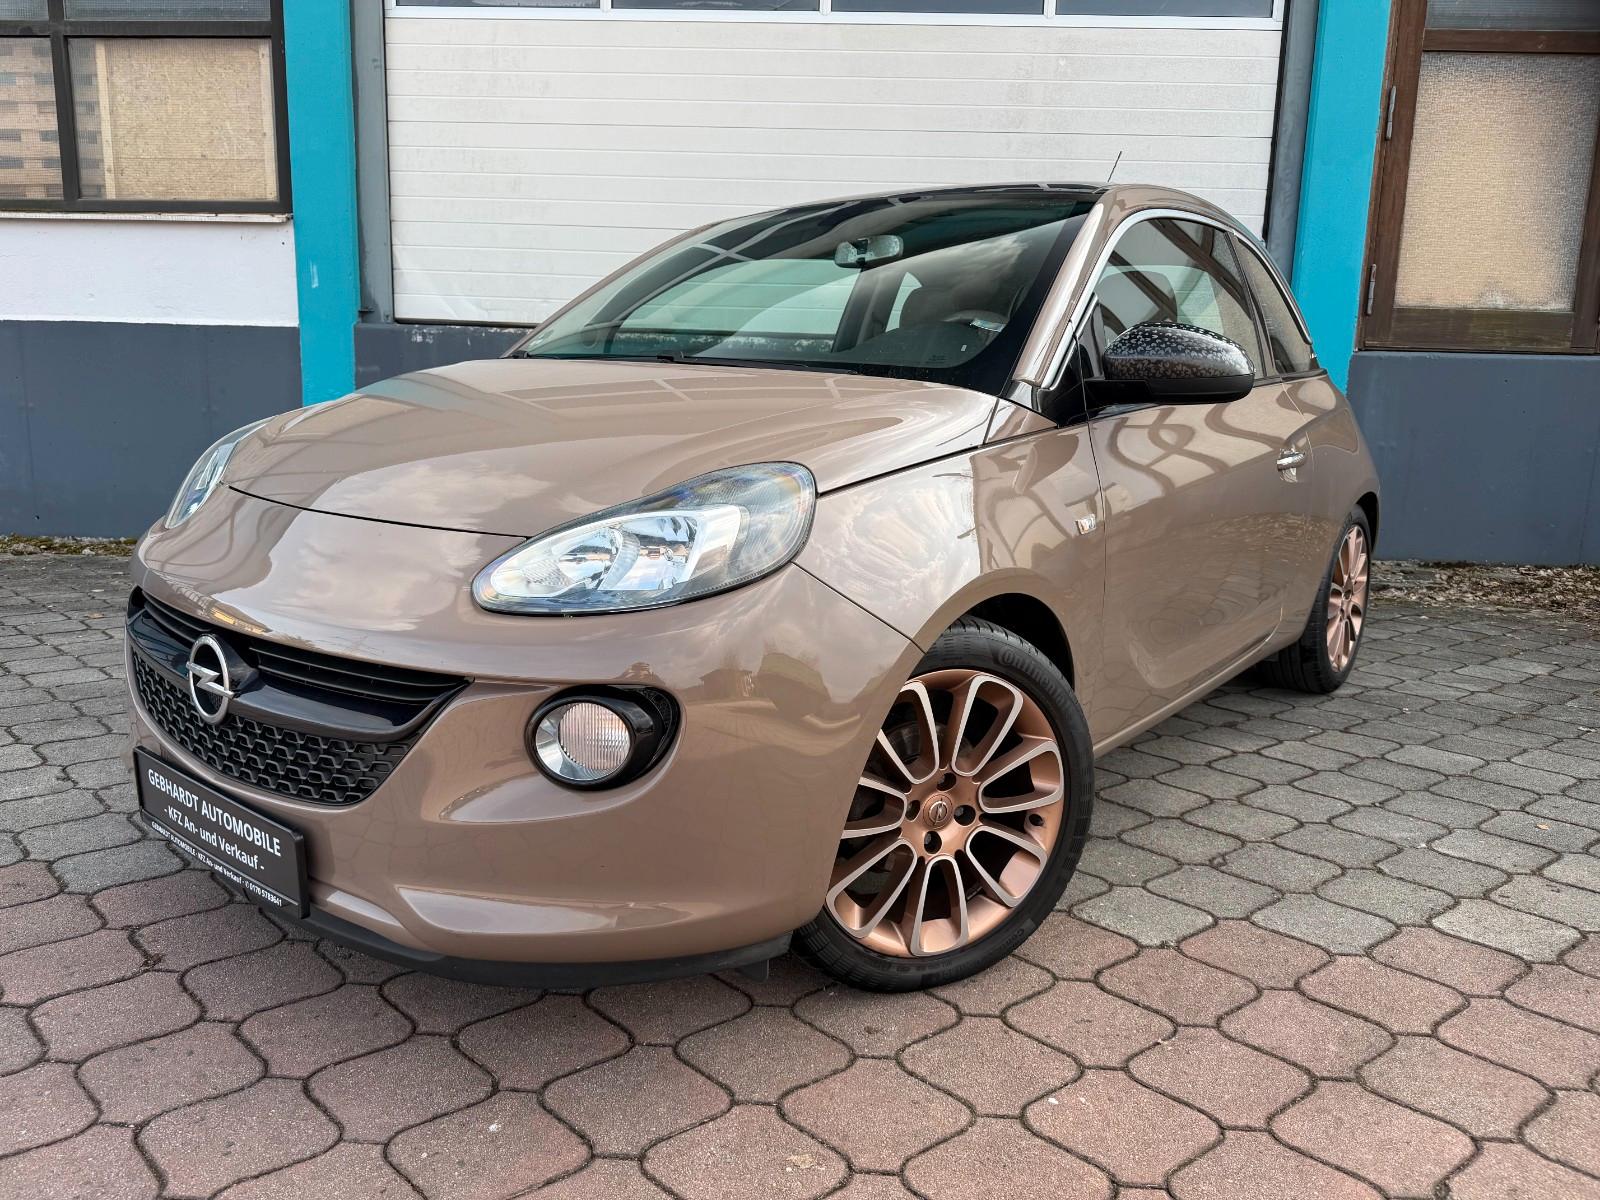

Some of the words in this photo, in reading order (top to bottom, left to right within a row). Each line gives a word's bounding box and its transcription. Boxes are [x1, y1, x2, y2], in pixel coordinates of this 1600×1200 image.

[148, 768, 198, 812] GEBHARDT
[201, 800, 281, 857] AUTOMOBILE
[168, 805, 183, 826] KFZ
[184, 815, 199, 834] An-
[200, 827, 217, 847] und
[219, 835, 258, 869] Verkauf
[151, 821, 171, 838] GEBHARDT
[170, 834, 196, 856] AUTOMOBILE
[223, 867, 242, 885] Verkauf
